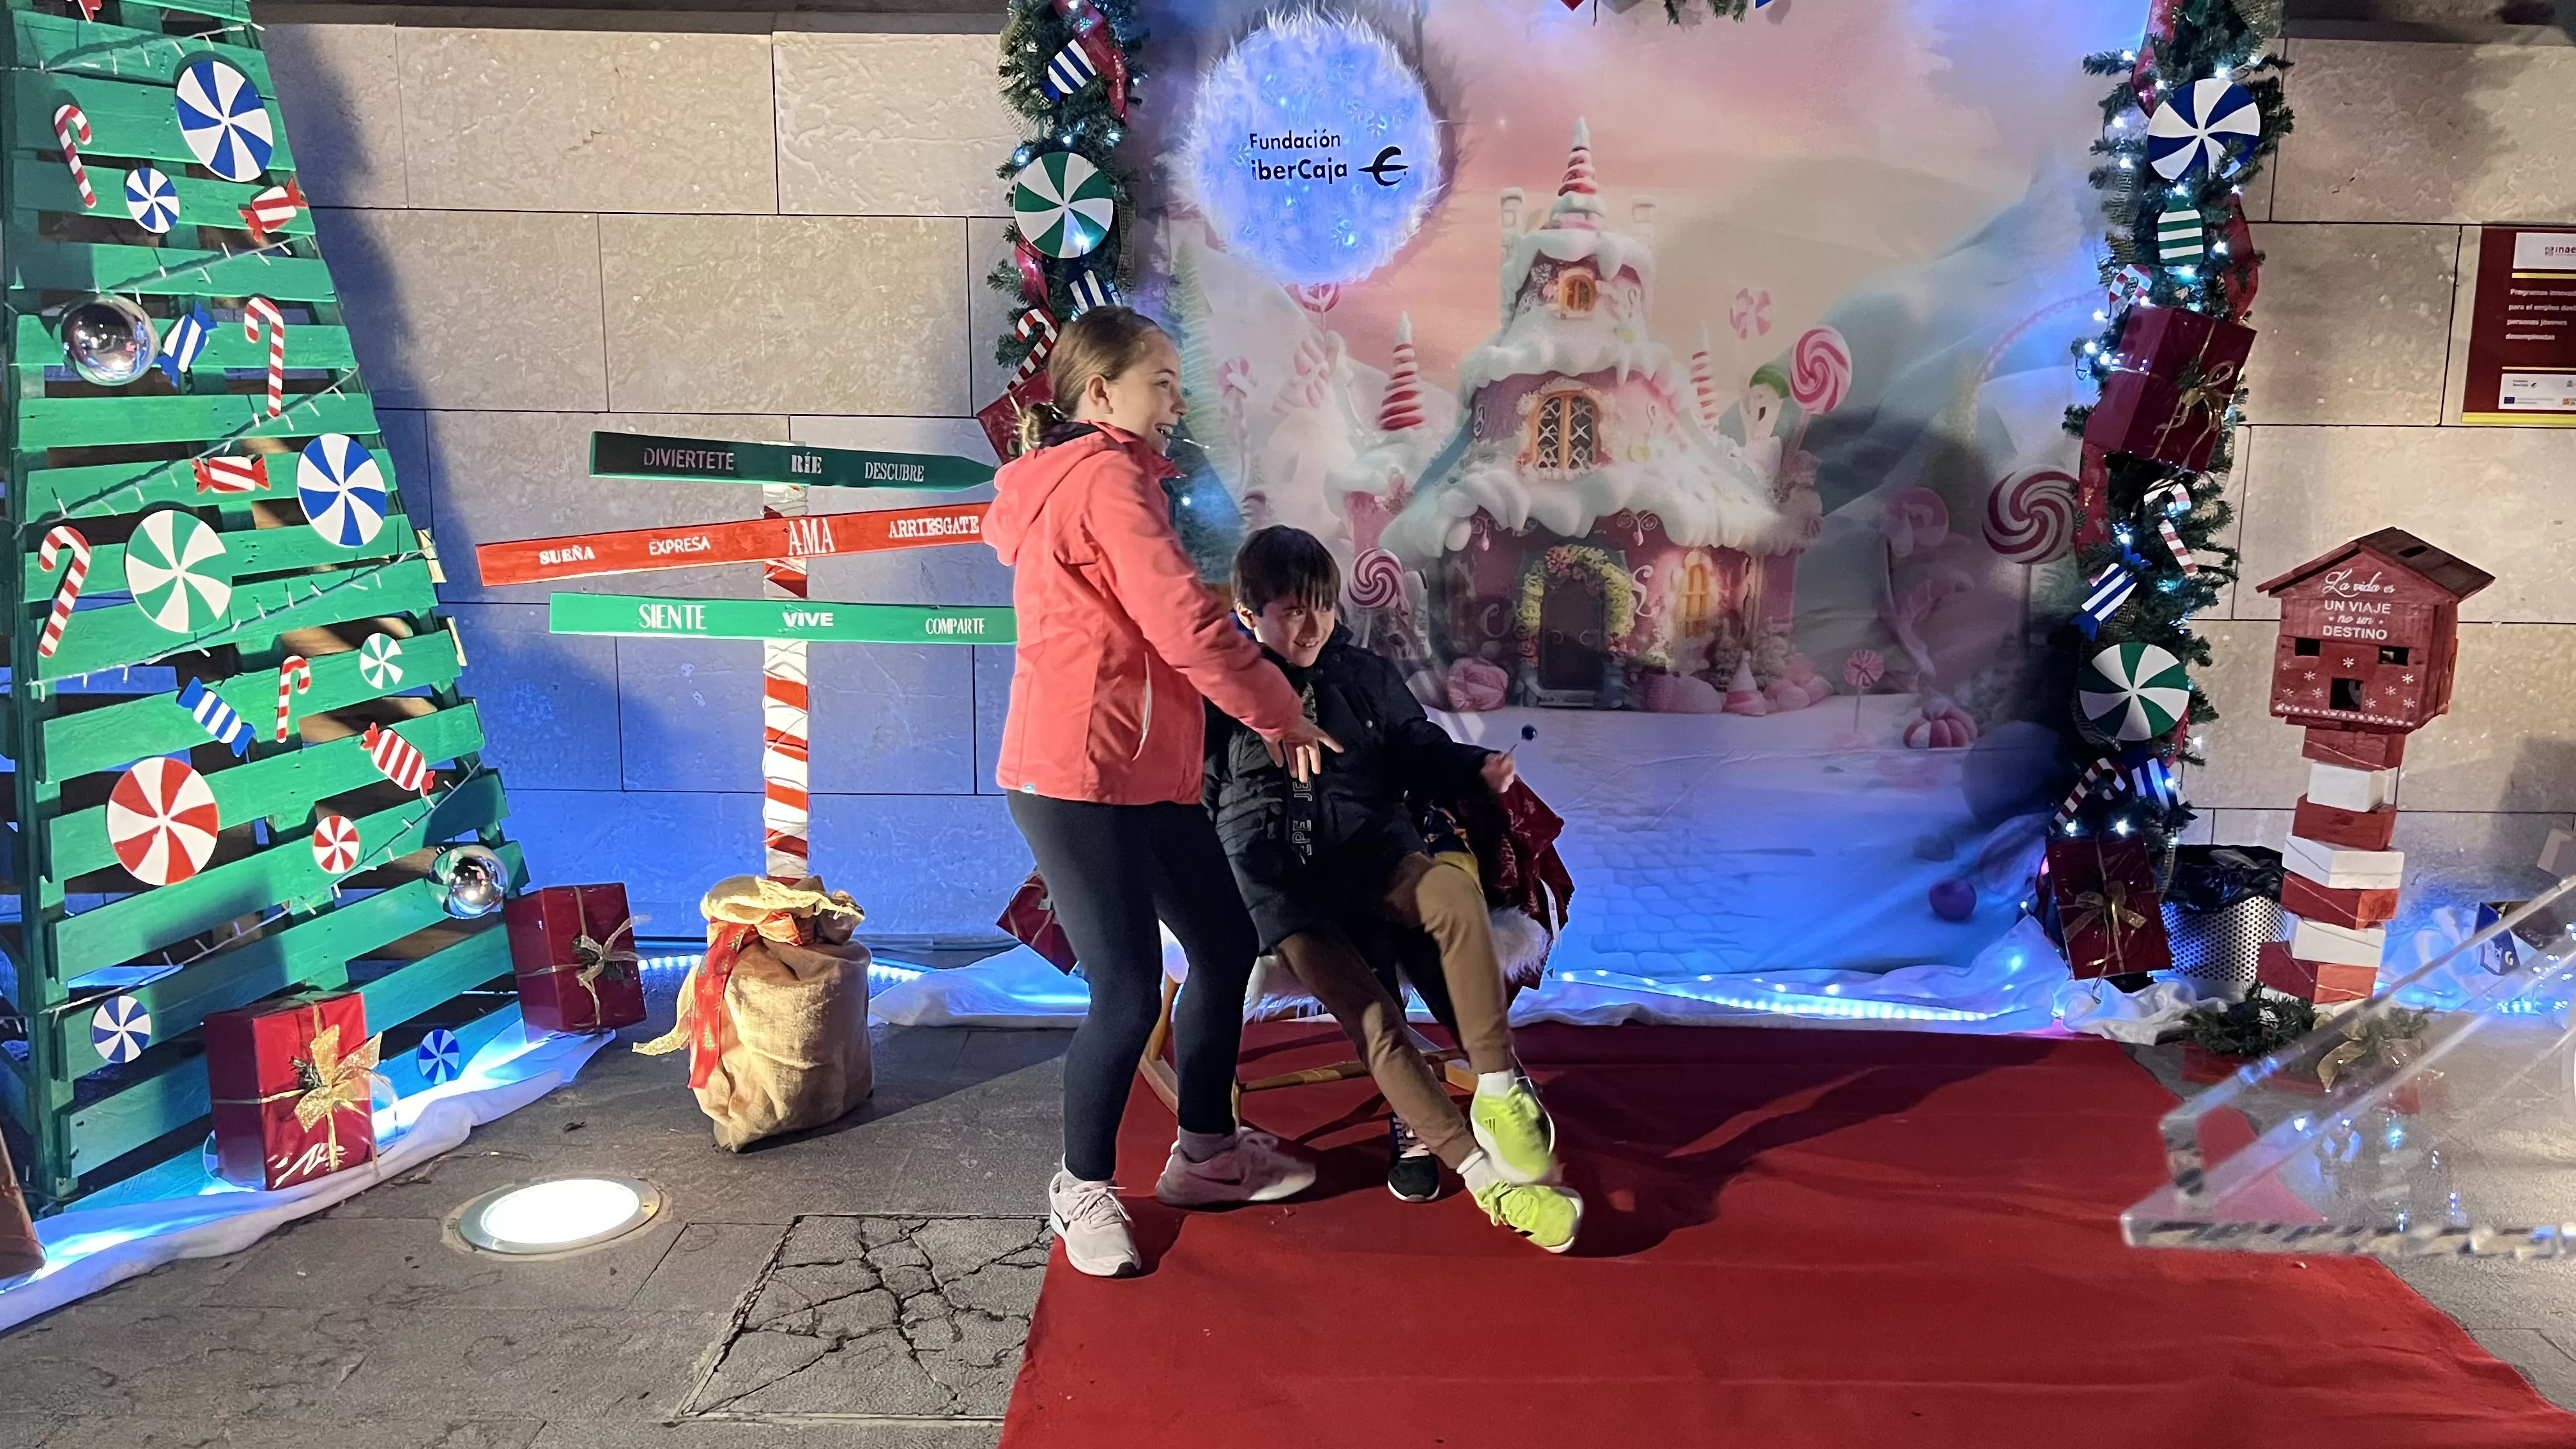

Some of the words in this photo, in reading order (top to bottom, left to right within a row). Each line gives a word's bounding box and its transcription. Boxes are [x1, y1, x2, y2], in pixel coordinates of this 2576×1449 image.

[1249, 128, 1341, 150] Fundación
[643, 447, 735, 471] DIVIERTETE
[791, 451, 822, 475] RÍE
[864, 461, 925, 482] DESCUBRE
[539, 544, 595, 565] SUEÑA
[648, 535, 711, 556] EXPRESA
[787, 518, 836, 556] AMA
[889, 515, 979, 539] ARRIESGATE
[2322, 568, 2358, 598] La
[2353, 571, 2382, 593] vida
[2383, 583, 2396, 594] es
[638, 603, 707, 631] SIENTE
[781, 611, 834, 628] VIVE
[925, 618, 986, 634] COMPARTE
[2324, 600, 2345, 611] UN
[2349, 601, 2391, 615] VIAJE
[2336, 615, 2353, 624] no
[2356, 616, 2373, 625] un
[2322, 625, 2388, 640] DESTINO
